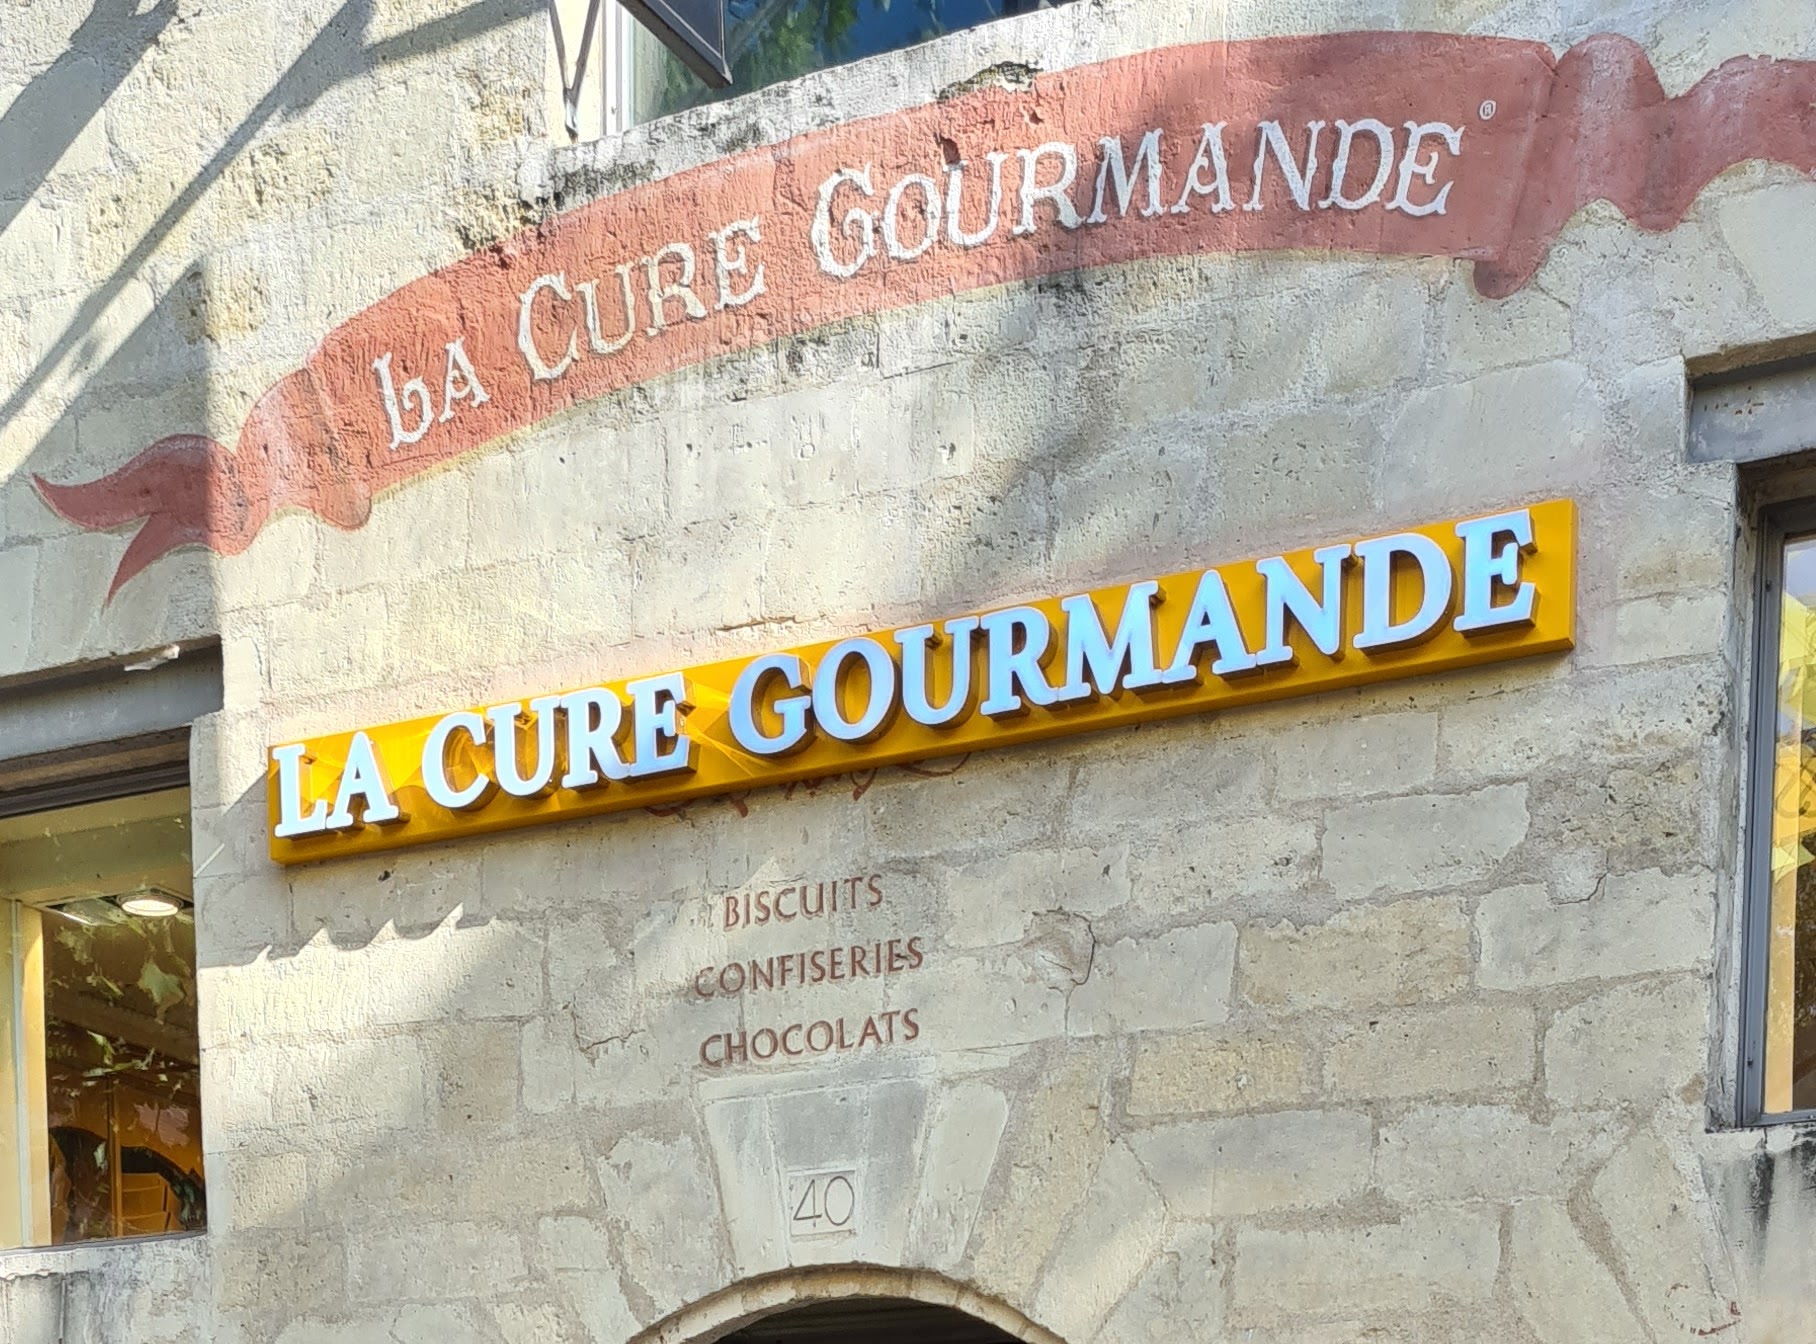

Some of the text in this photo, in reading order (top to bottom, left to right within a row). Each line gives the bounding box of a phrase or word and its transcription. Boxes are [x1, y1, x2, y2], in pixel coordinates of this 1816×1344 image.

[372, 337, 491, 450] LA
[516, 216, 768, 383] CURE
[273, 511, 1538, 839] LA CURE GOURMANDE
[723, 873, 884, 931] BISCUITS
[694, 936, 924, 999] CONFISERIES
[700, 1008, 920, 1068] CHOCOLATS
[791, 1175, 855, 1228] 40
